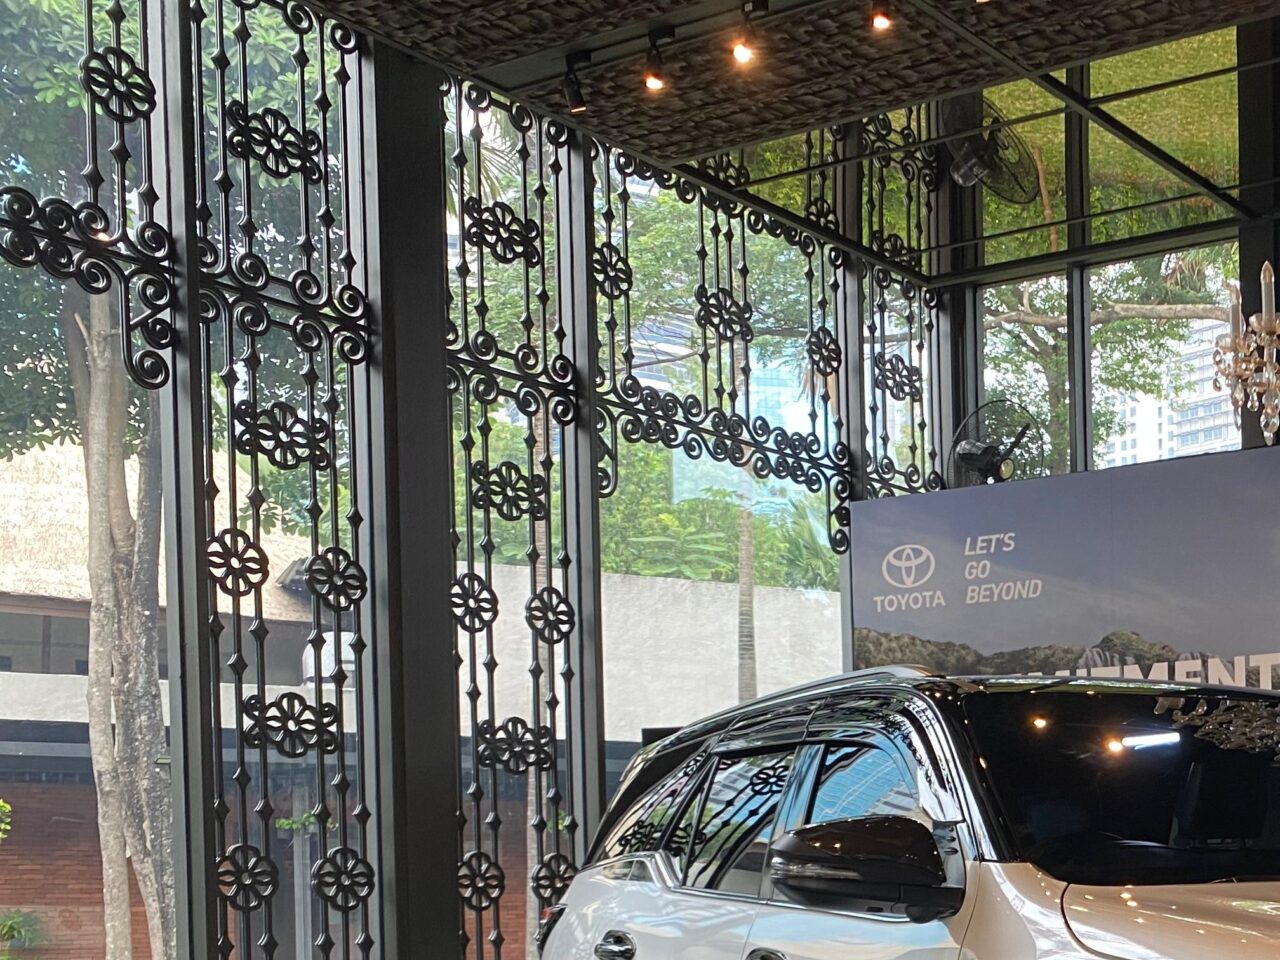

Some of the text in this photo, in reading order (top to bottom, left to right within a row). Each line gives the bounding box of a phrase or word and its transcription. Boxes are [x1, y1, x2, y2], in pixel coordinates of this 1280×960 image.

[964, 532, 1016, 556] LET'S
[964, 559, 991, 580] GO
[873, 590, 946, 613] TOYOTA
[965, 579, 1042, 604] BEYOND
